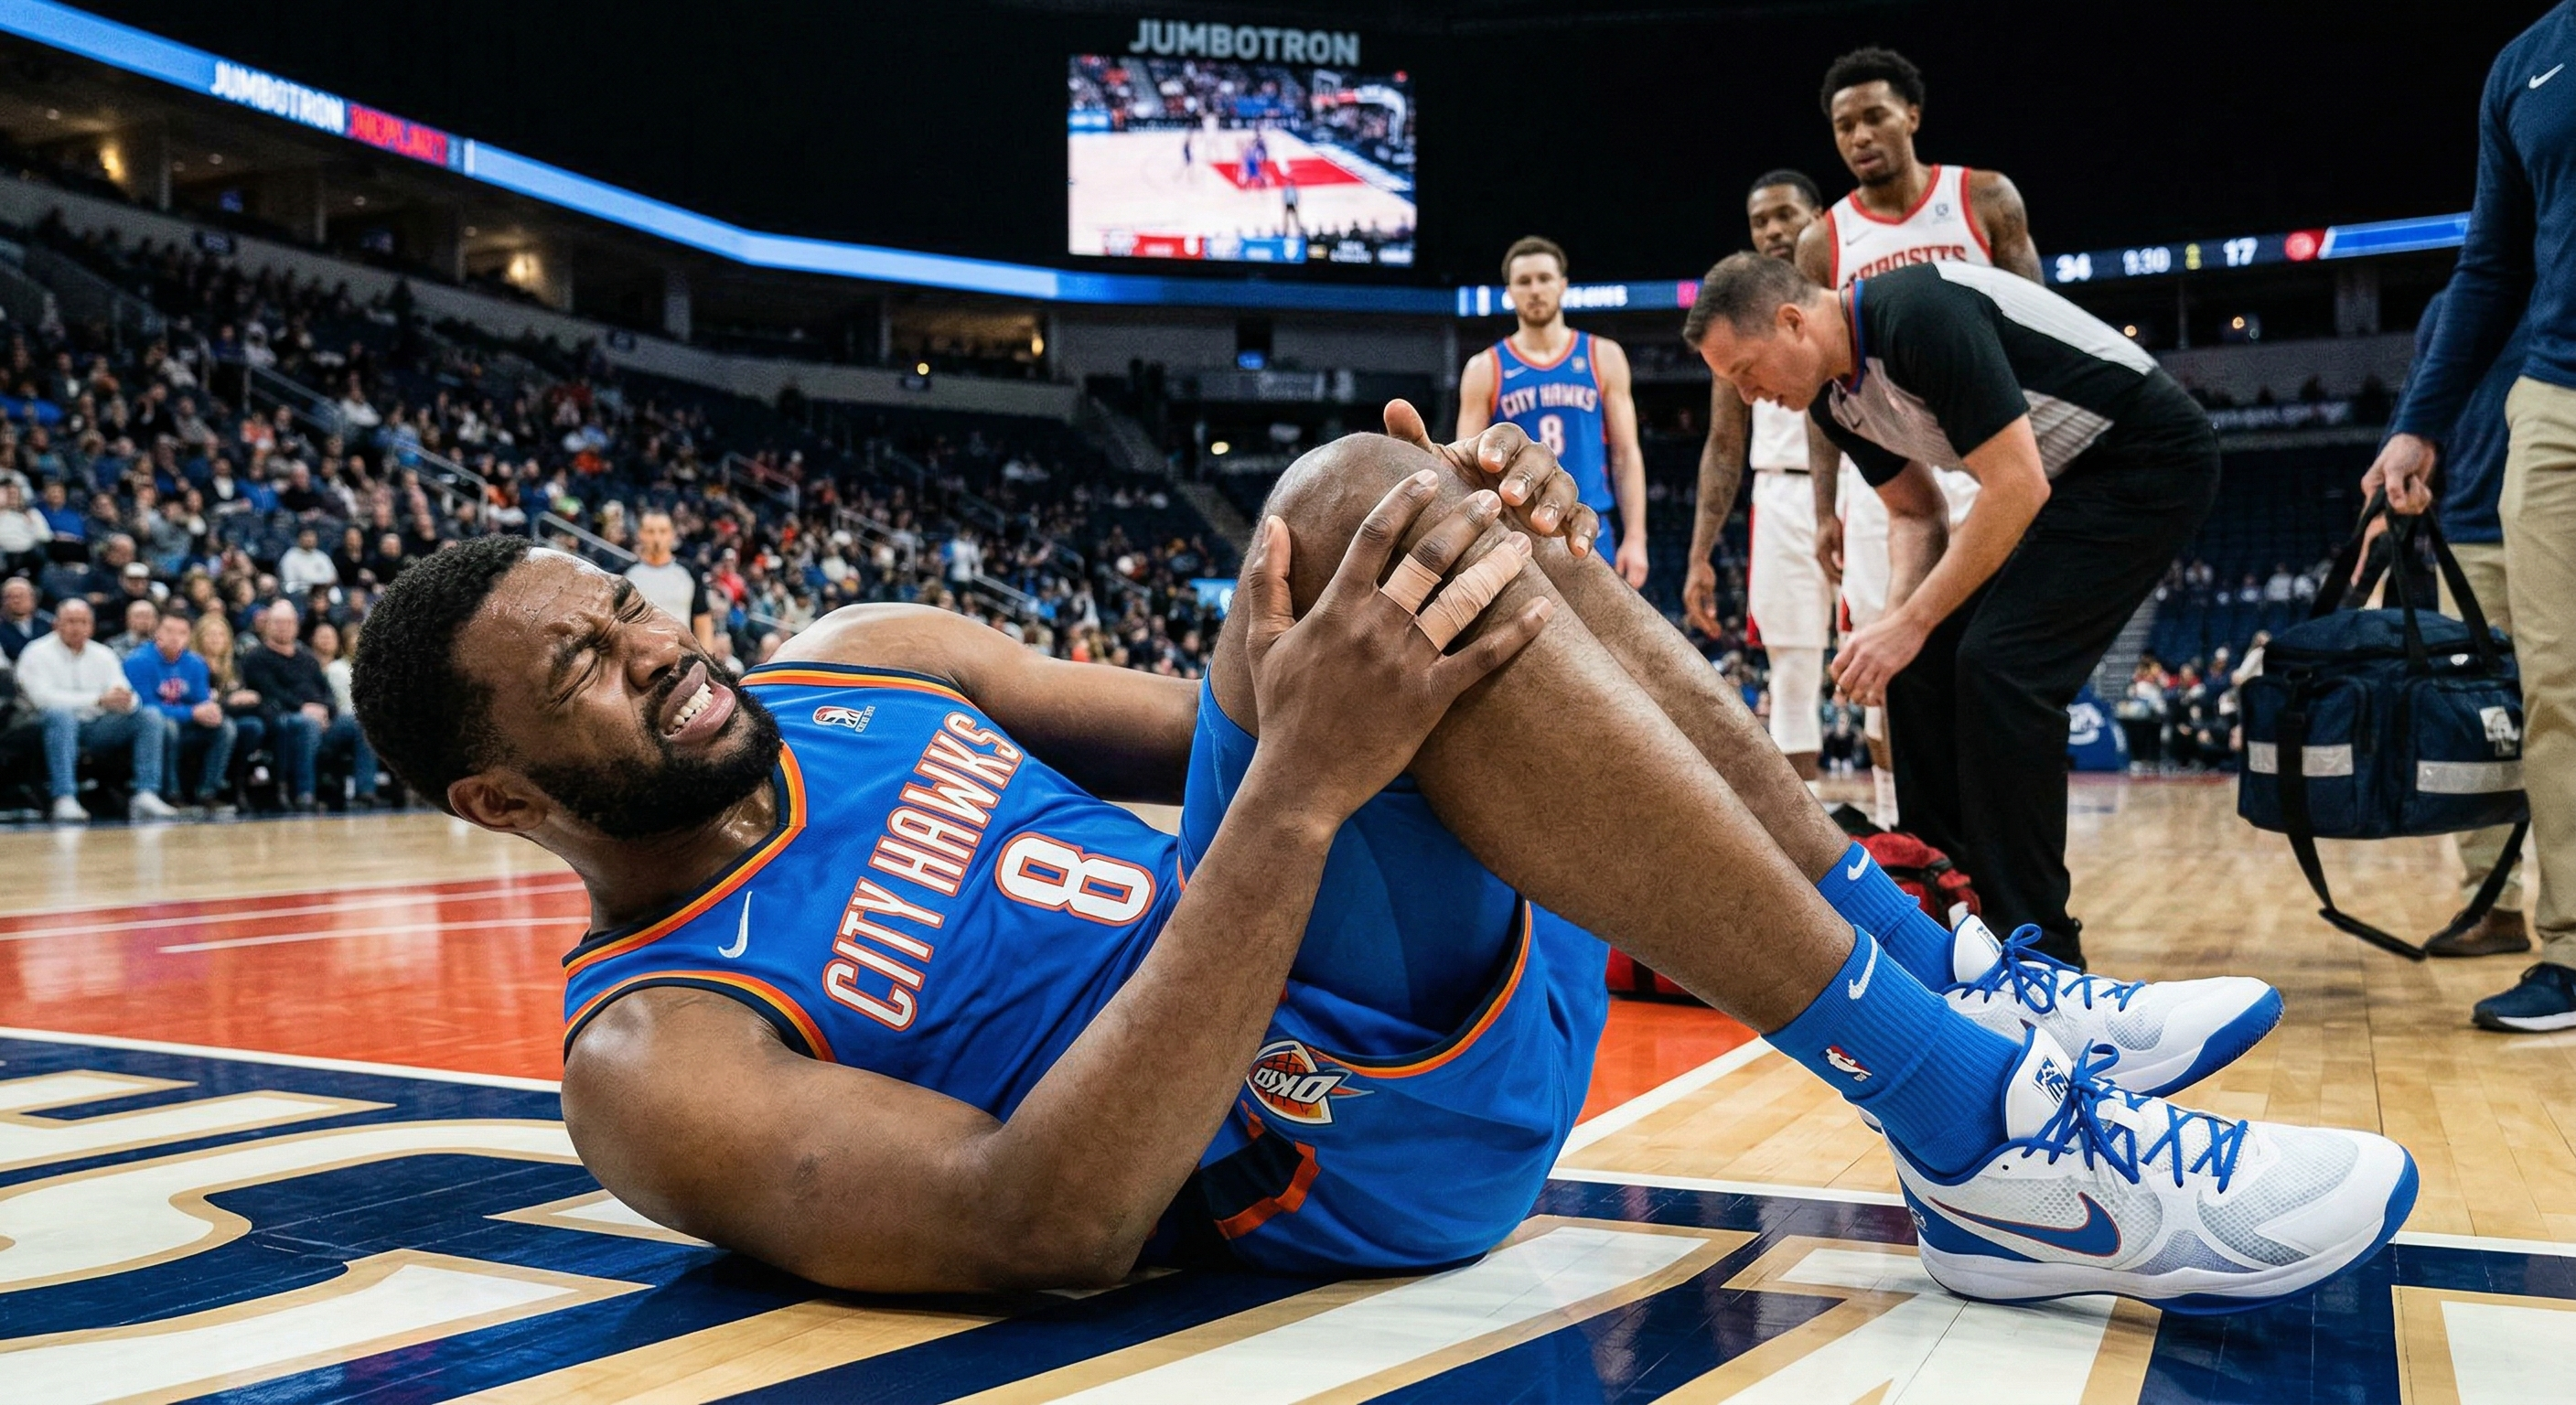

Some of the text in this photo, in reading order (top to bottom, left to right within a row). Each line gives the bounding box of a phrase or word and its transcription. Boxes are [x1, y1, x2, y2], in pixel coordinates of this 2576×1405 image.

[1129, 19, 1359, 66] JUMBOTRON
[1500, 382, 1597, 420] CITY HAWKS
[1540, 415, 1564, 456] 8
[823, 712, 1023, 1031] CITY HAWKS
[994, 831, 1157, 927] 8
